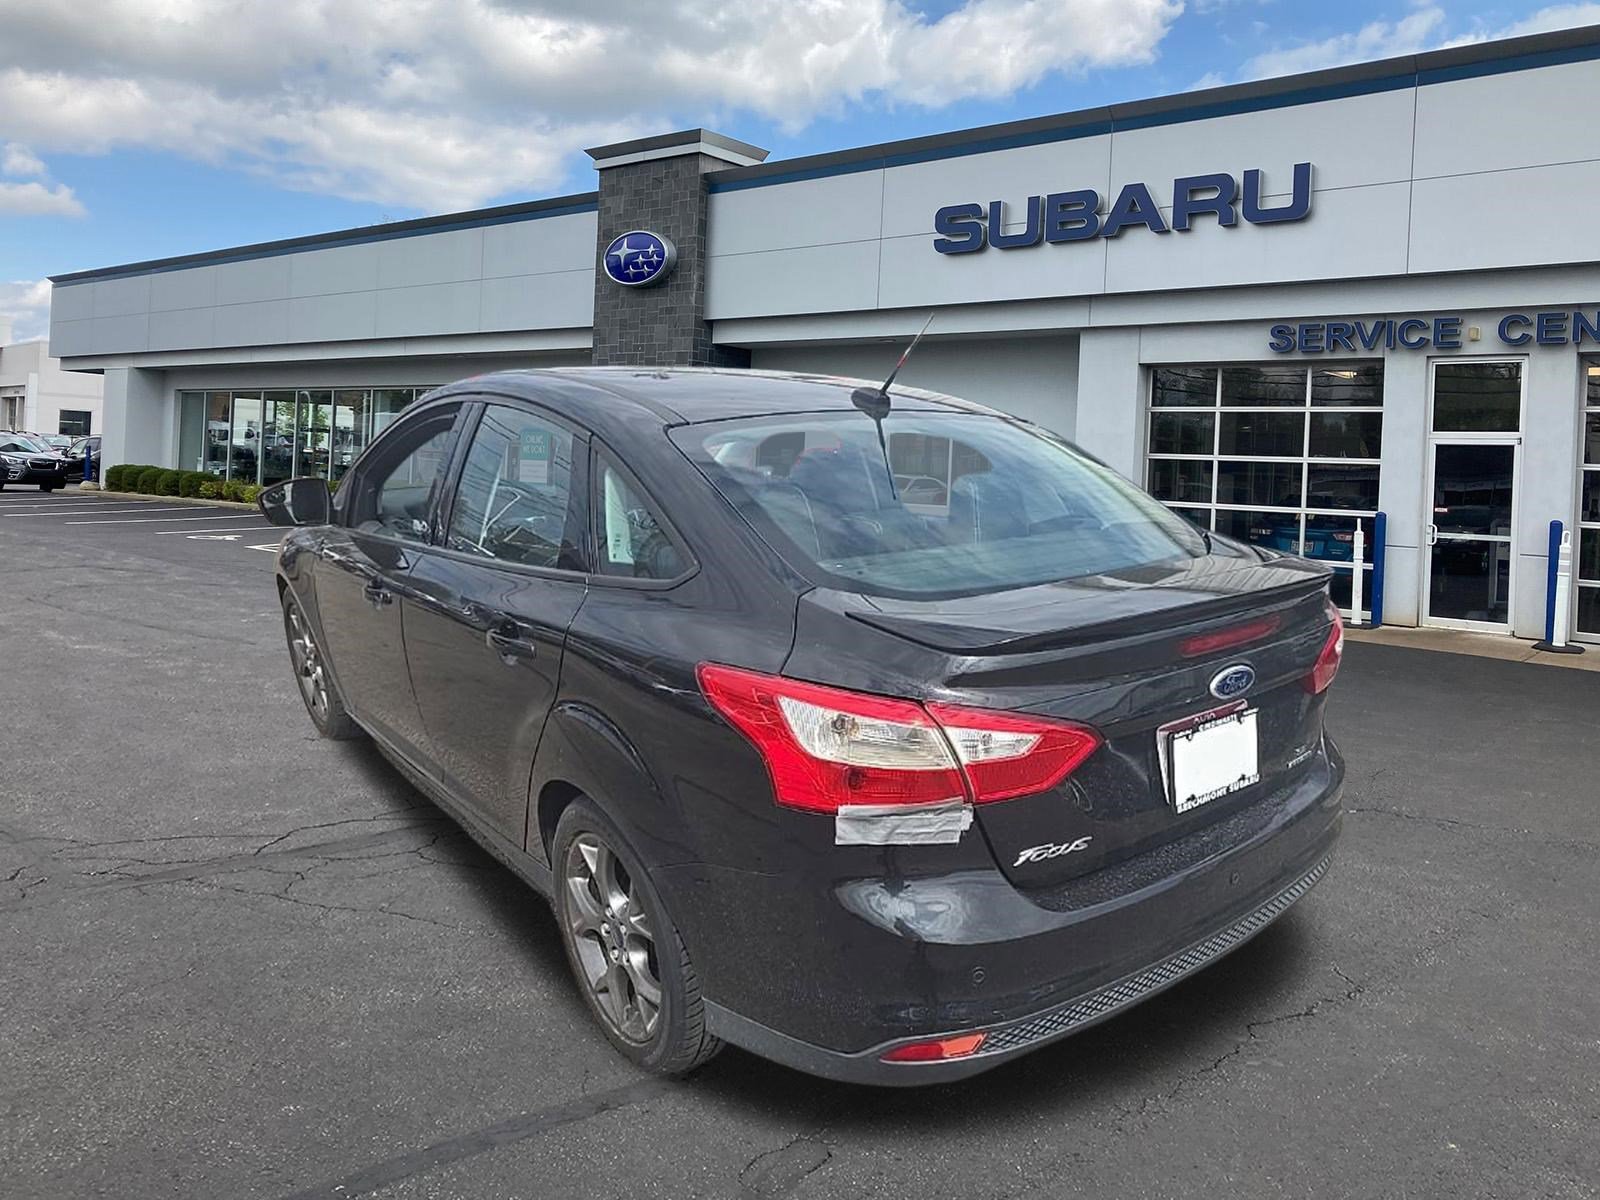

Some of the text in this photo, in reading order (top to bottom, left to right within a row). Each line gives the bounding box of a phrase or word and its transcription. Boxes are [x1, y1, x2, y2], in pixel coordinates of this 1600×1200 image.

[933, 162, 1315, 255] SUBARU
[1269, 311, 1600, 352] SERVICE CEN
